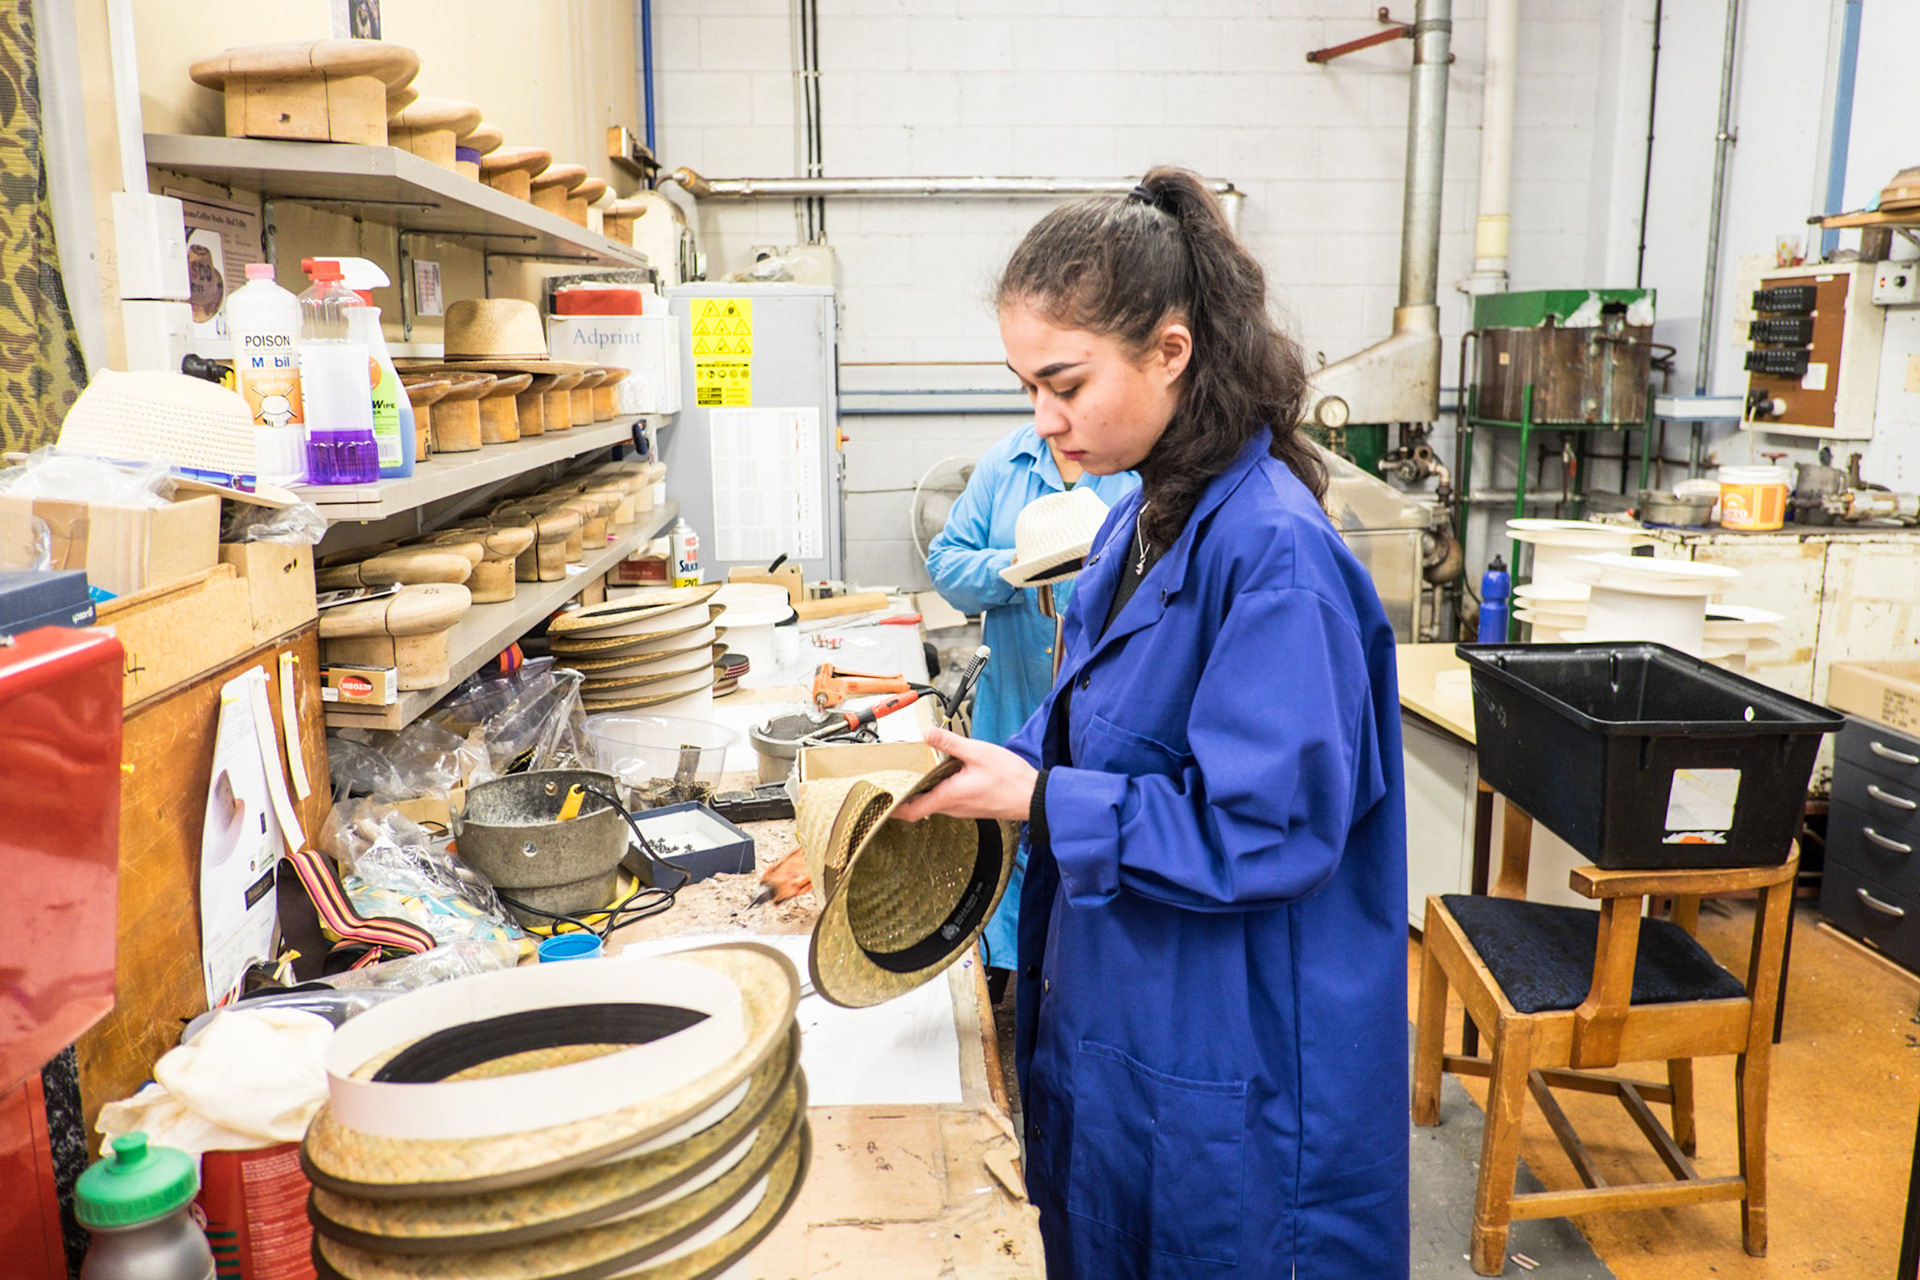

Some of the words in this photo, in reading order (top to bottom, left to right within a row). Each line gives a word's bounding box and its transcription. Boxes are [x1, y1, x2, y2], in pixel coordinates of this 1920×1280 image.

[245, 335, 291, 347] POISON
[573, 327, 641, 350] Adprint
[251, 356, 291, 368] Mobil
[123, 651, 146, 685] 4
